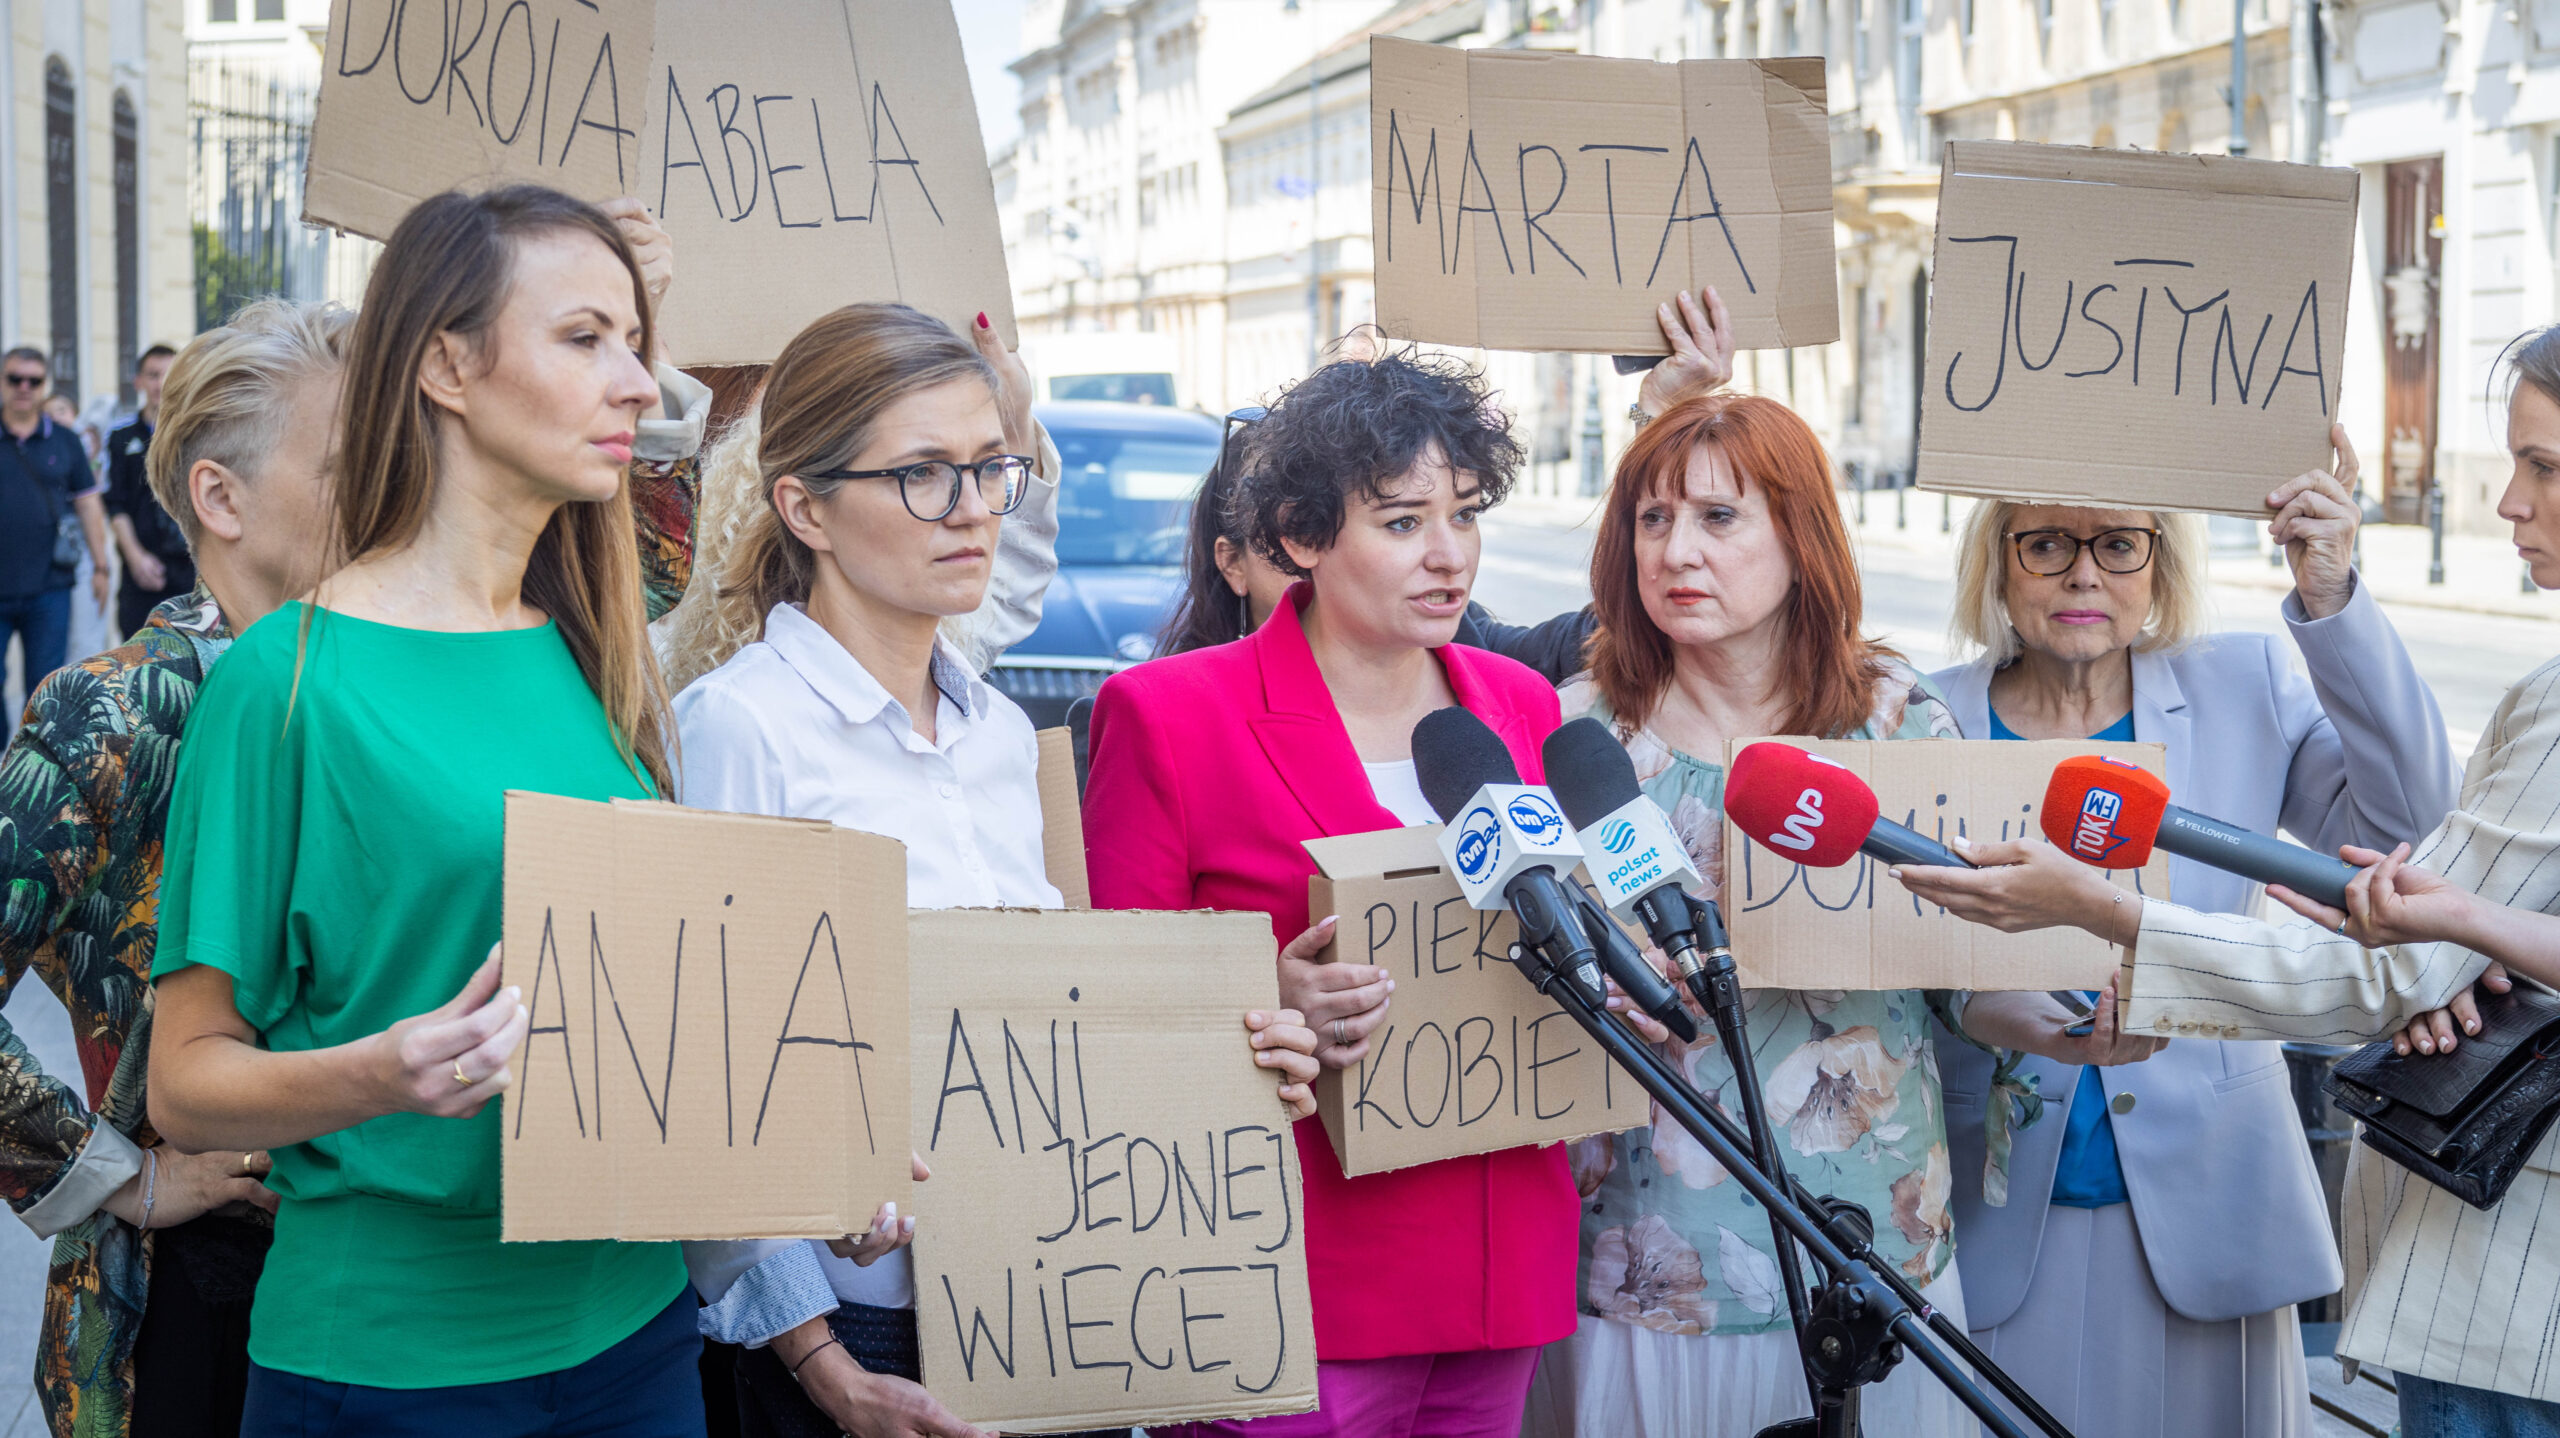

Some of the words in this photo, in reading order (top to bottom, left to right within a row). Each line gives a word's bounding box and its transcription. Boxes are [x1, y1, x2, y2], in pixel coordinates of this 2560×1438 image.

[648, 64, 944, 228] ABELA
[1387, 108, 1757, 294] MARTA
[1945, 235, 2328, 416] JUSTYNA
[2086, 791, 2117, 820] FM
[2074, 814, 2111, 855] TOK
[2185, 820, 2241, 846] YELLOWTEC
[1608, 845, 1661, 886] polsat
[1620, 863, 1663, 895] news
[1036, 1125, 1293, 1253] JEDNEJ
